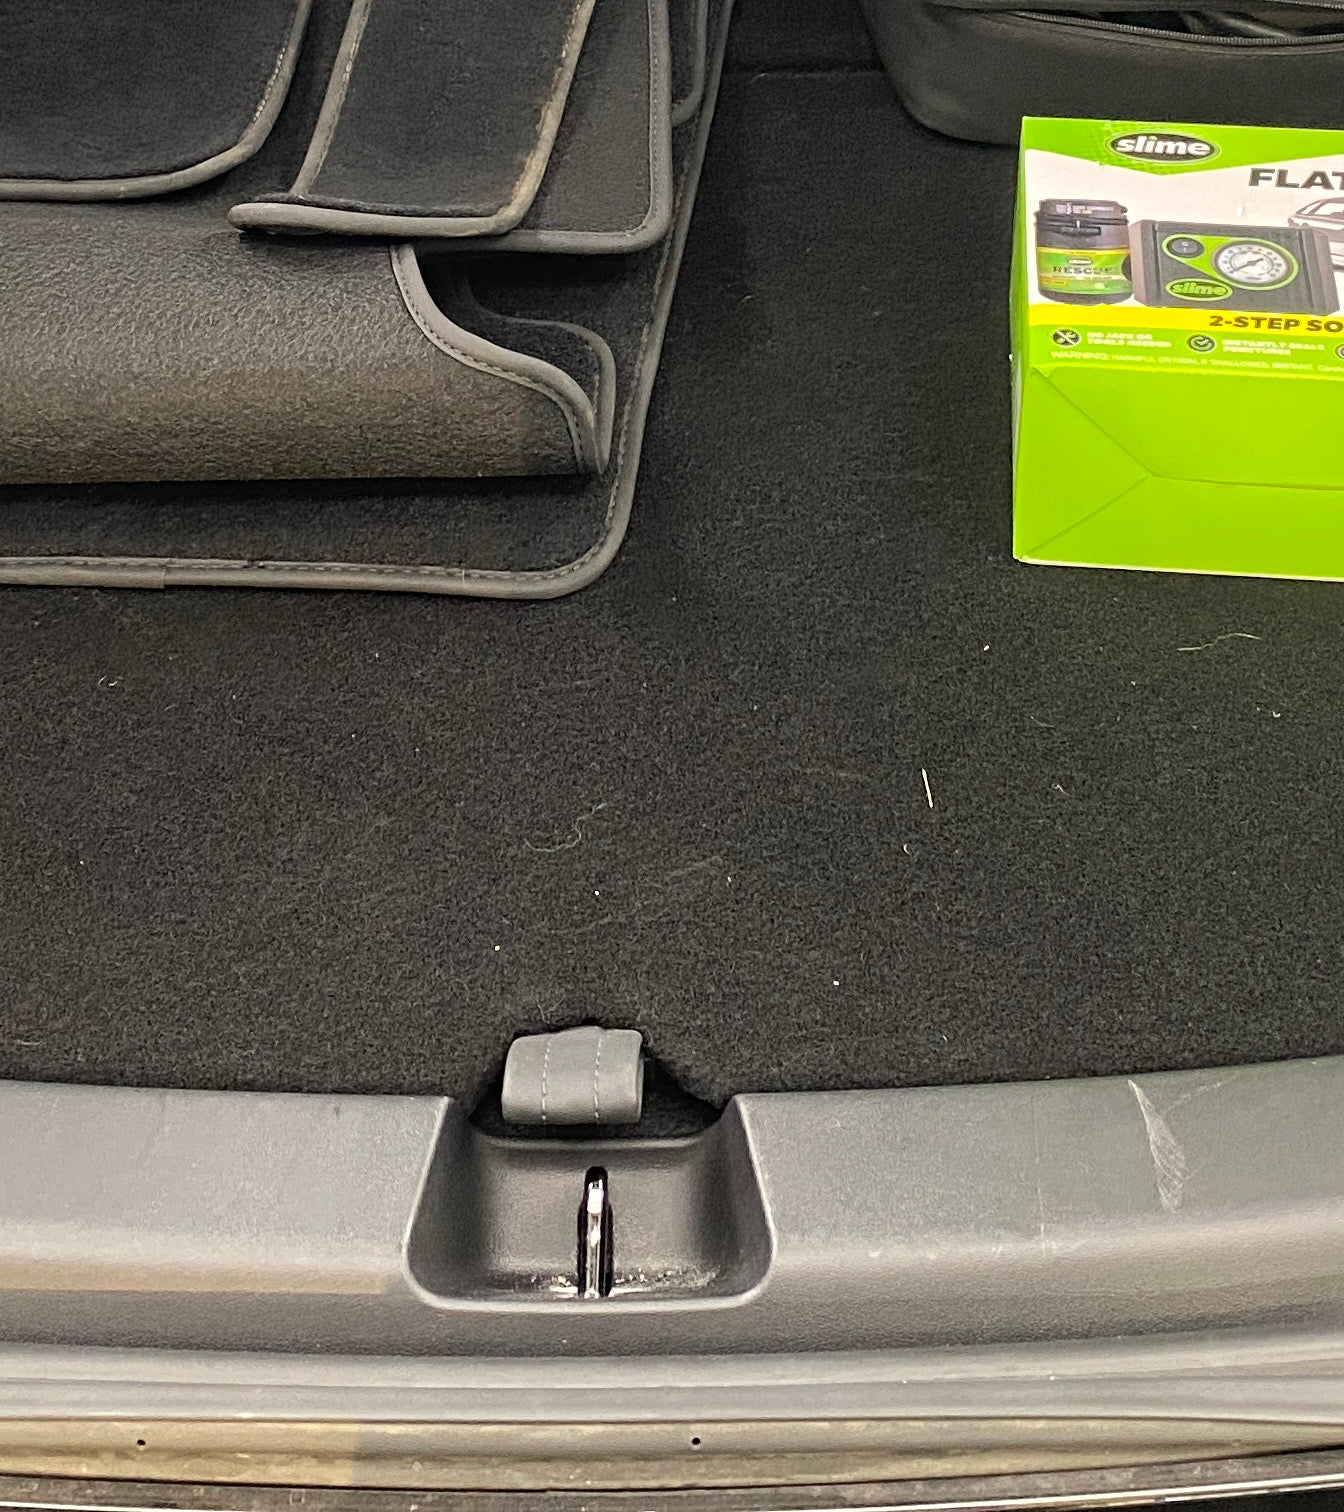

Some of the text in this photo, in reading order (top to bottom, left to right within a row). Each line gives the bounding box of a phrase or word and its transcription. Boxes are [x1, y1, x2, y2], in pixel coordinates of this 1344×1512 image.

[1116, 135, 1211, 156] slime
[1171, 282, 1228, 296] slime
[1208, 315, 1301, 331] 2-STEP
